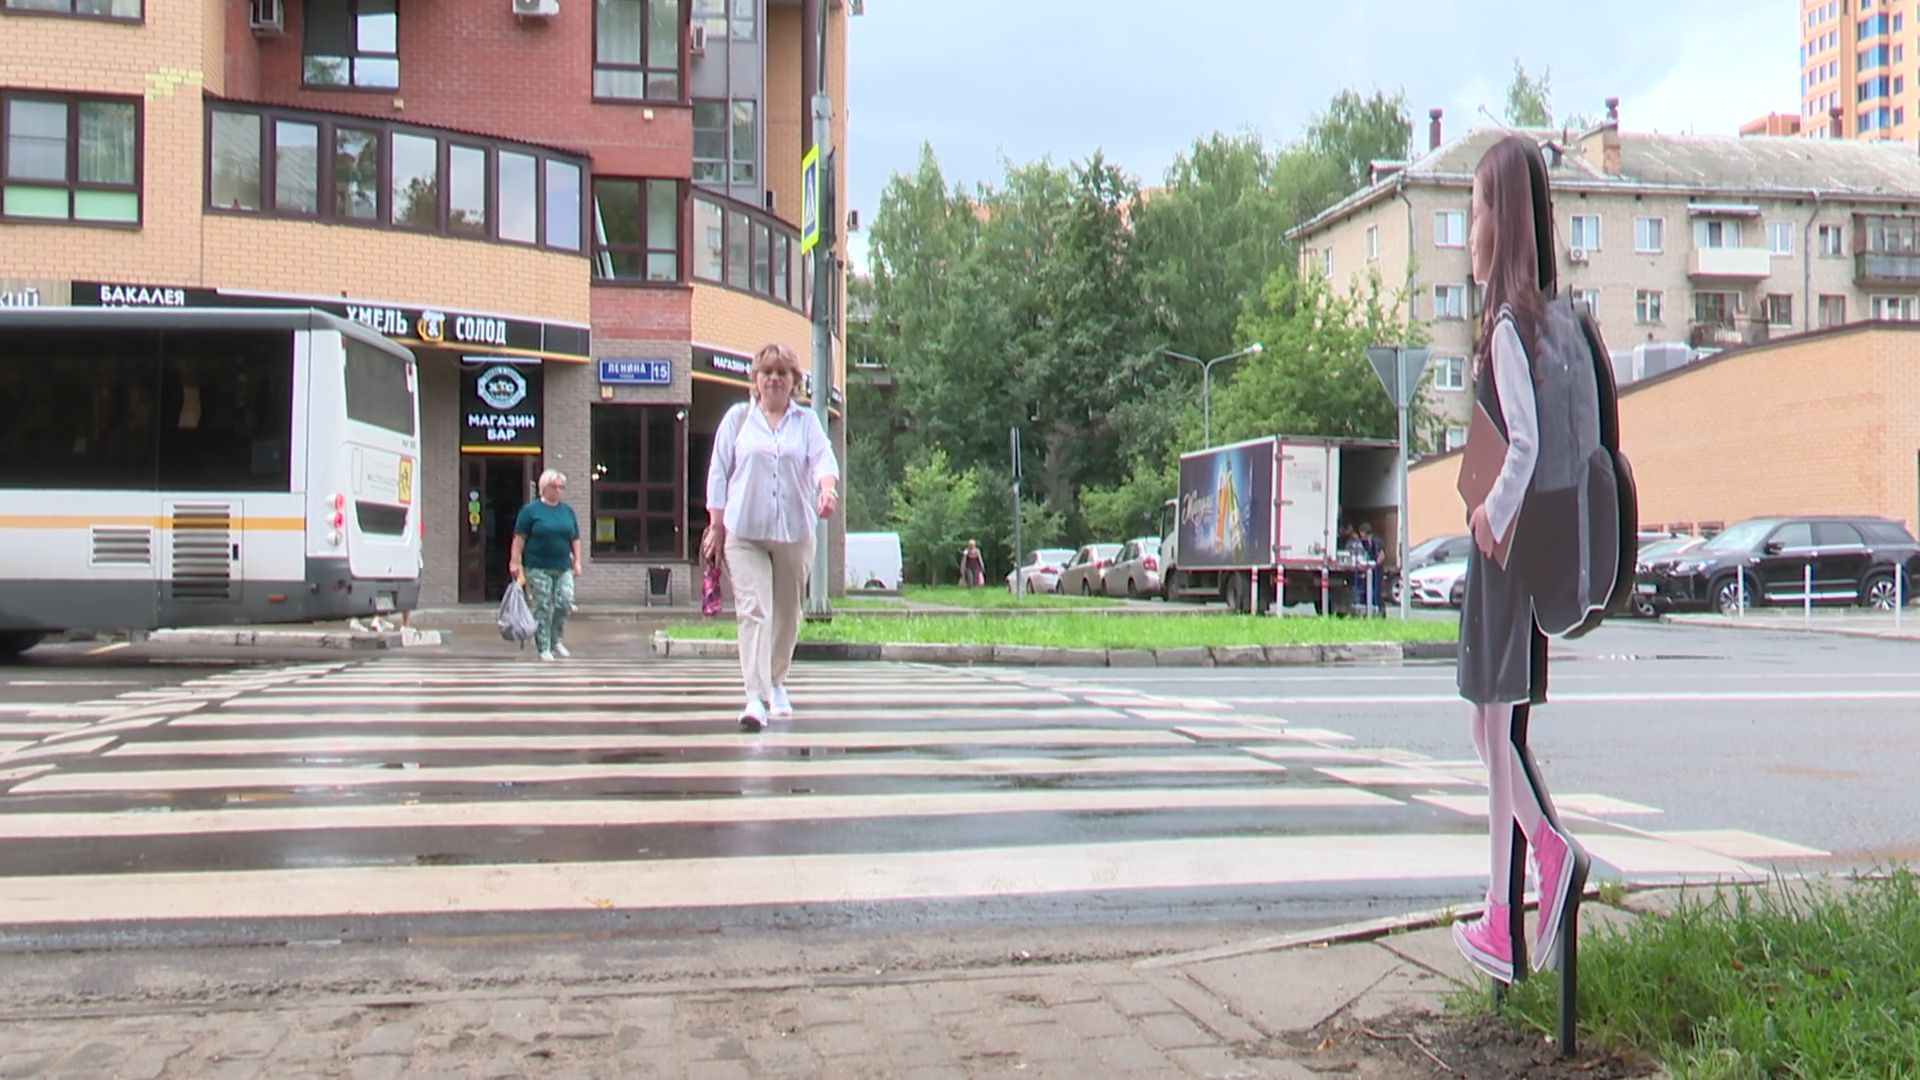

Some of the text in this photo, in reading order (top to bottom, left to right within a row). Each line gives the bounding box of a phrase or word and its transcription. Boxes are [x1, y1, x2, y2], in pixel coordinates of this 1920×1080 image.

[100, 285, 185, 305] БАКАЛЕЯ
[455, 316, 507, 345] СОЛОД
[607, 362, 668, 379] ЛЕНИНА 15
[468, 413, 536, 429] МАГАЗИН
[487, 428, 517, 442] БАР
